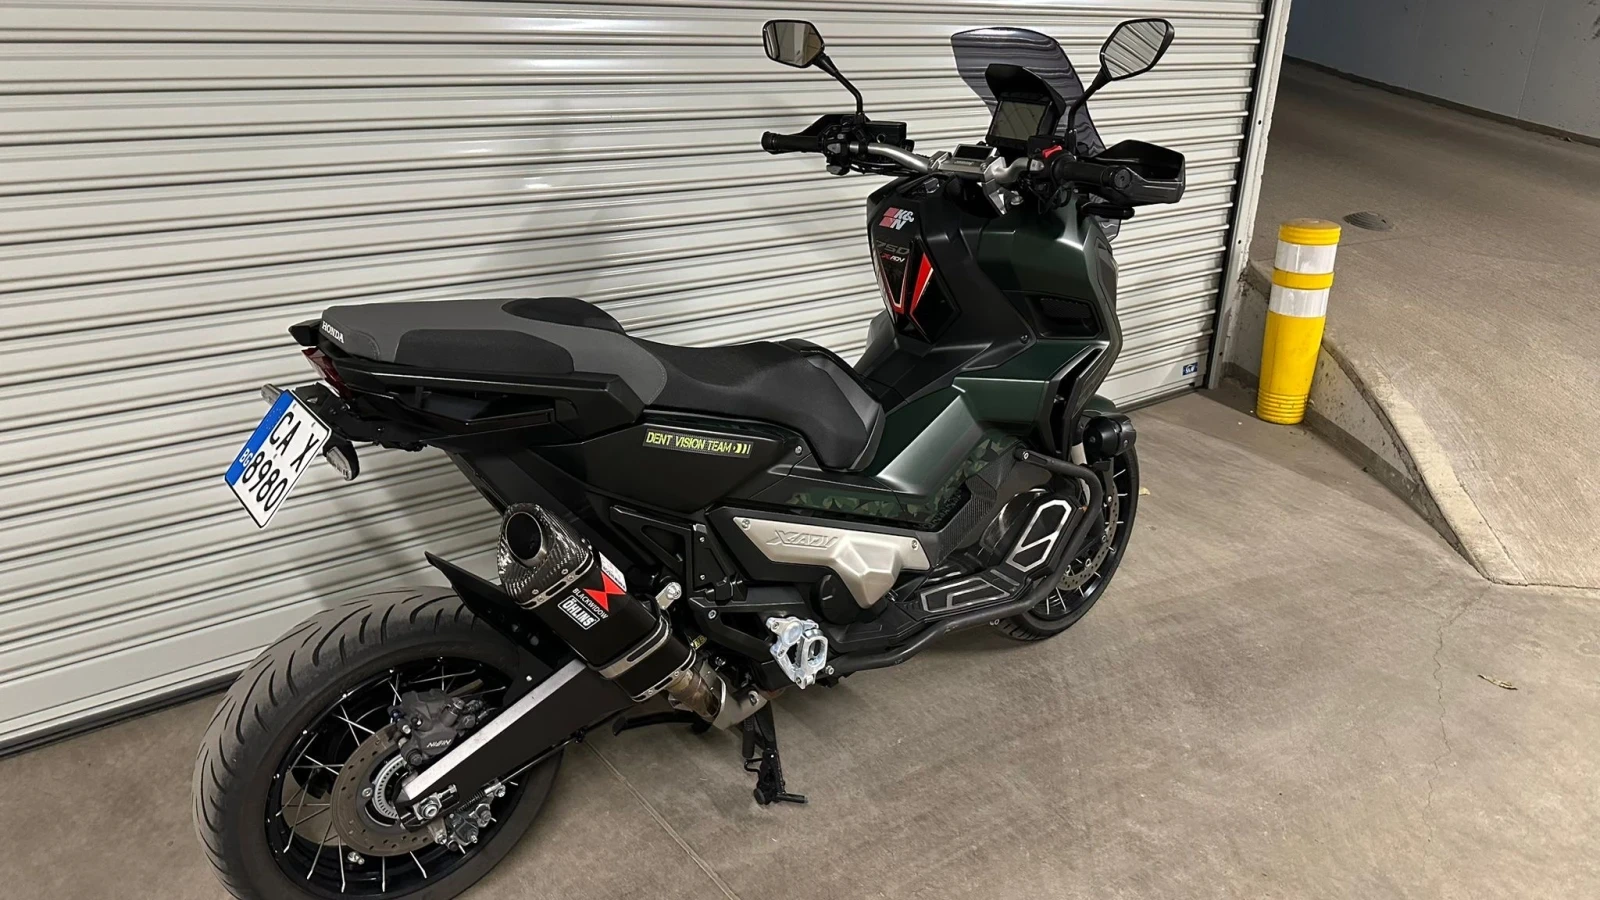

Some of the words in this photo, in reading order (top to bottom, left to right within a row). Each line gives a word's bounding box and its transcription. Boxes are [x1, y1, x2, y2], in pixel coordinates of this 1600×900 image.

[876, 240, 910, 255] 750
[321, 320, 344, 344] HONDA
[269, 411, 302, 457] CA
[290, 432, 320, 472] X
[645, 431, 673, 446] DENT
[675, 435, 706, 450] VISION
[707, 440, 732, 453] TEAM
[238, 446, 254, 467] BG
[242, 450, 289, 512] 8980
[571, 587, 609, 619] BLACKWIDOW
